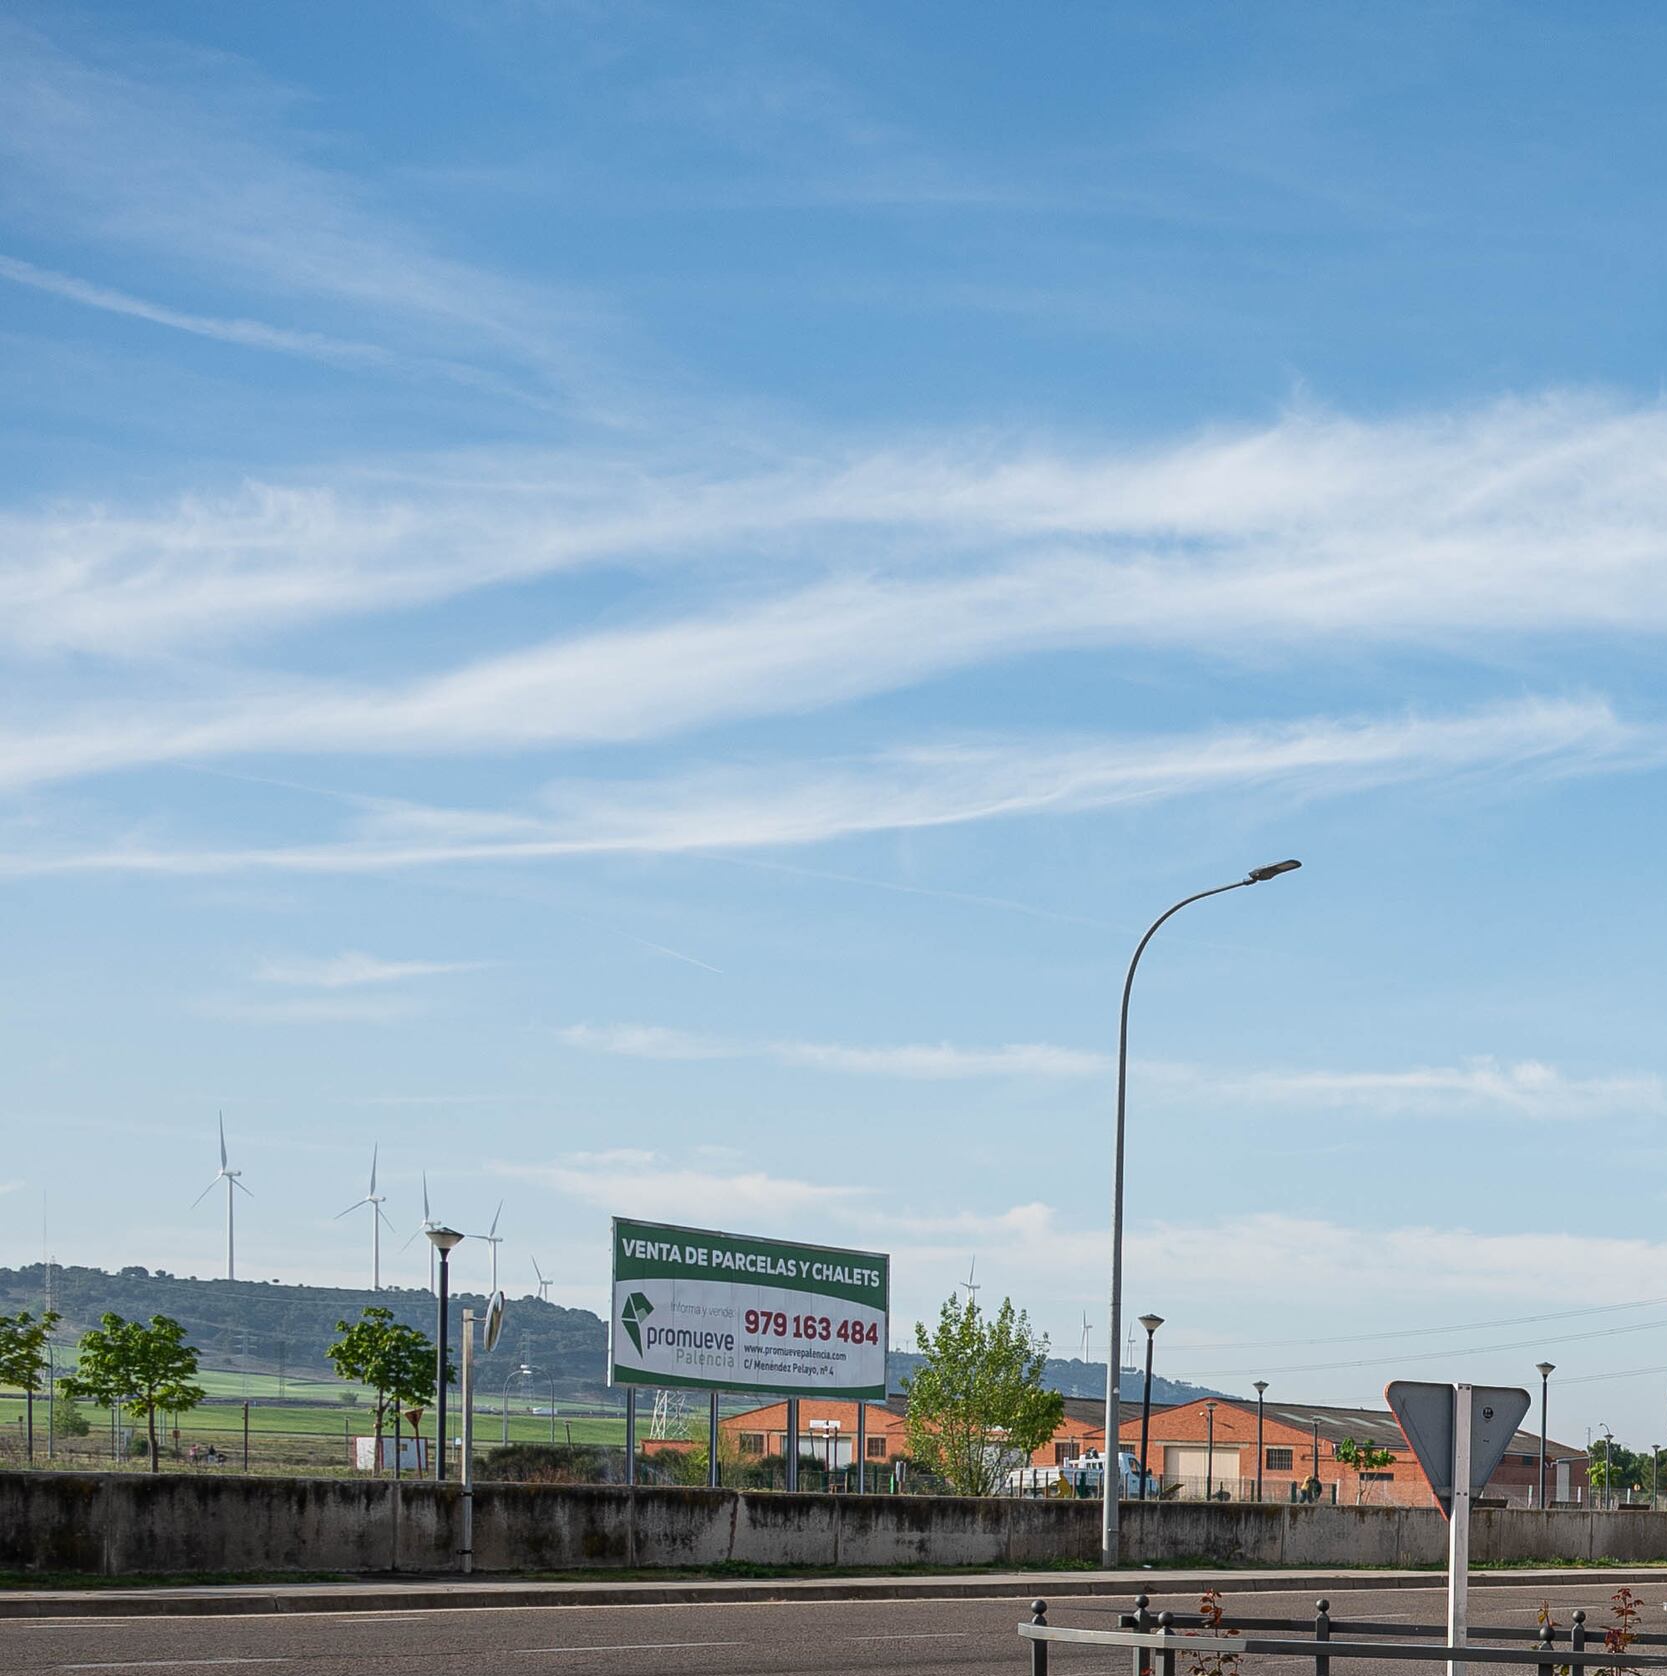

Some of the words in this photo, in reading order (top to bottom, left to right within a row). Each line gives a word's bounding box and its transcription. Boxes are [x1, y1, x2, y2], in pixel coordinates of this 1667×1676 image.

[622, 1238, 682, 1263] VENTA
[685, 1246, 708, 1266] DE
[712, 1250, 797, 1277] PARCELAS
[799, 1260, 811, 1279] Y
[812, 1263, 880, 1287] CHALETS
[647, 1326, 735, 1351] promueve
[744, 1309, 788, 1337] 979
[793, 1314, 832, 1341] 163
[836, 1319, 879, 1346] 484
[676, 1349, 735, 1368] Palencia
[743, 1344, 847, 1361] www.promuevepalencia.com
[743, 1359, 752, 1370] C/
[792, 1363, 819, 1376] Pelayo,
